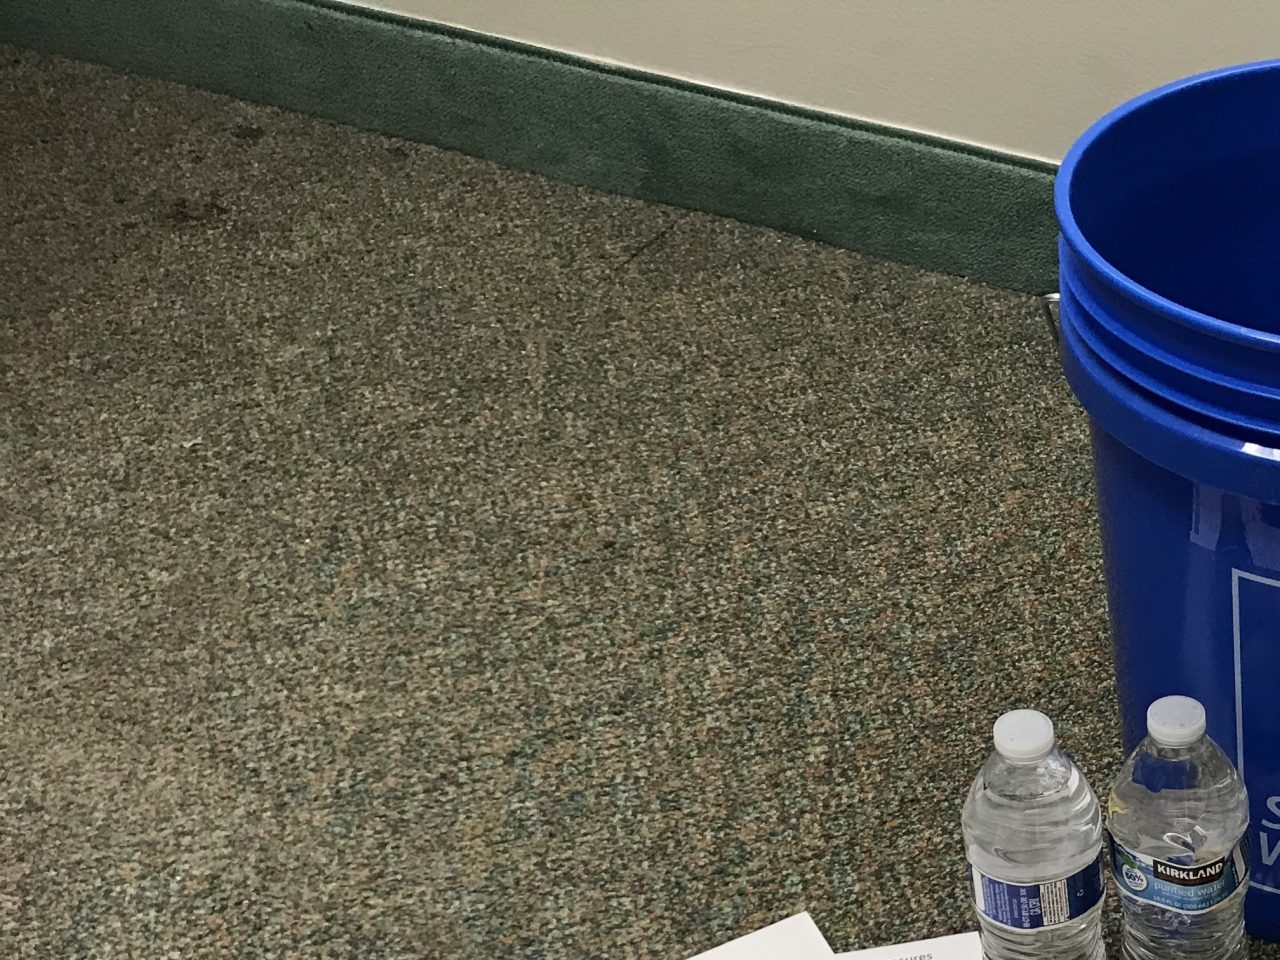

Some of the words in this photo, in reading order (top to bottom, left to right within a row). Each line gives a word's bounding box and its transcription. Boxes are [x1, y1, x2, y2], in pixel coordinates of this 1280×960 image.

[1157, 862, 1223, 880] KIRKLAND
[1154, 881, 1195, 897] purified
[1196, 879, 1225, 896] water
